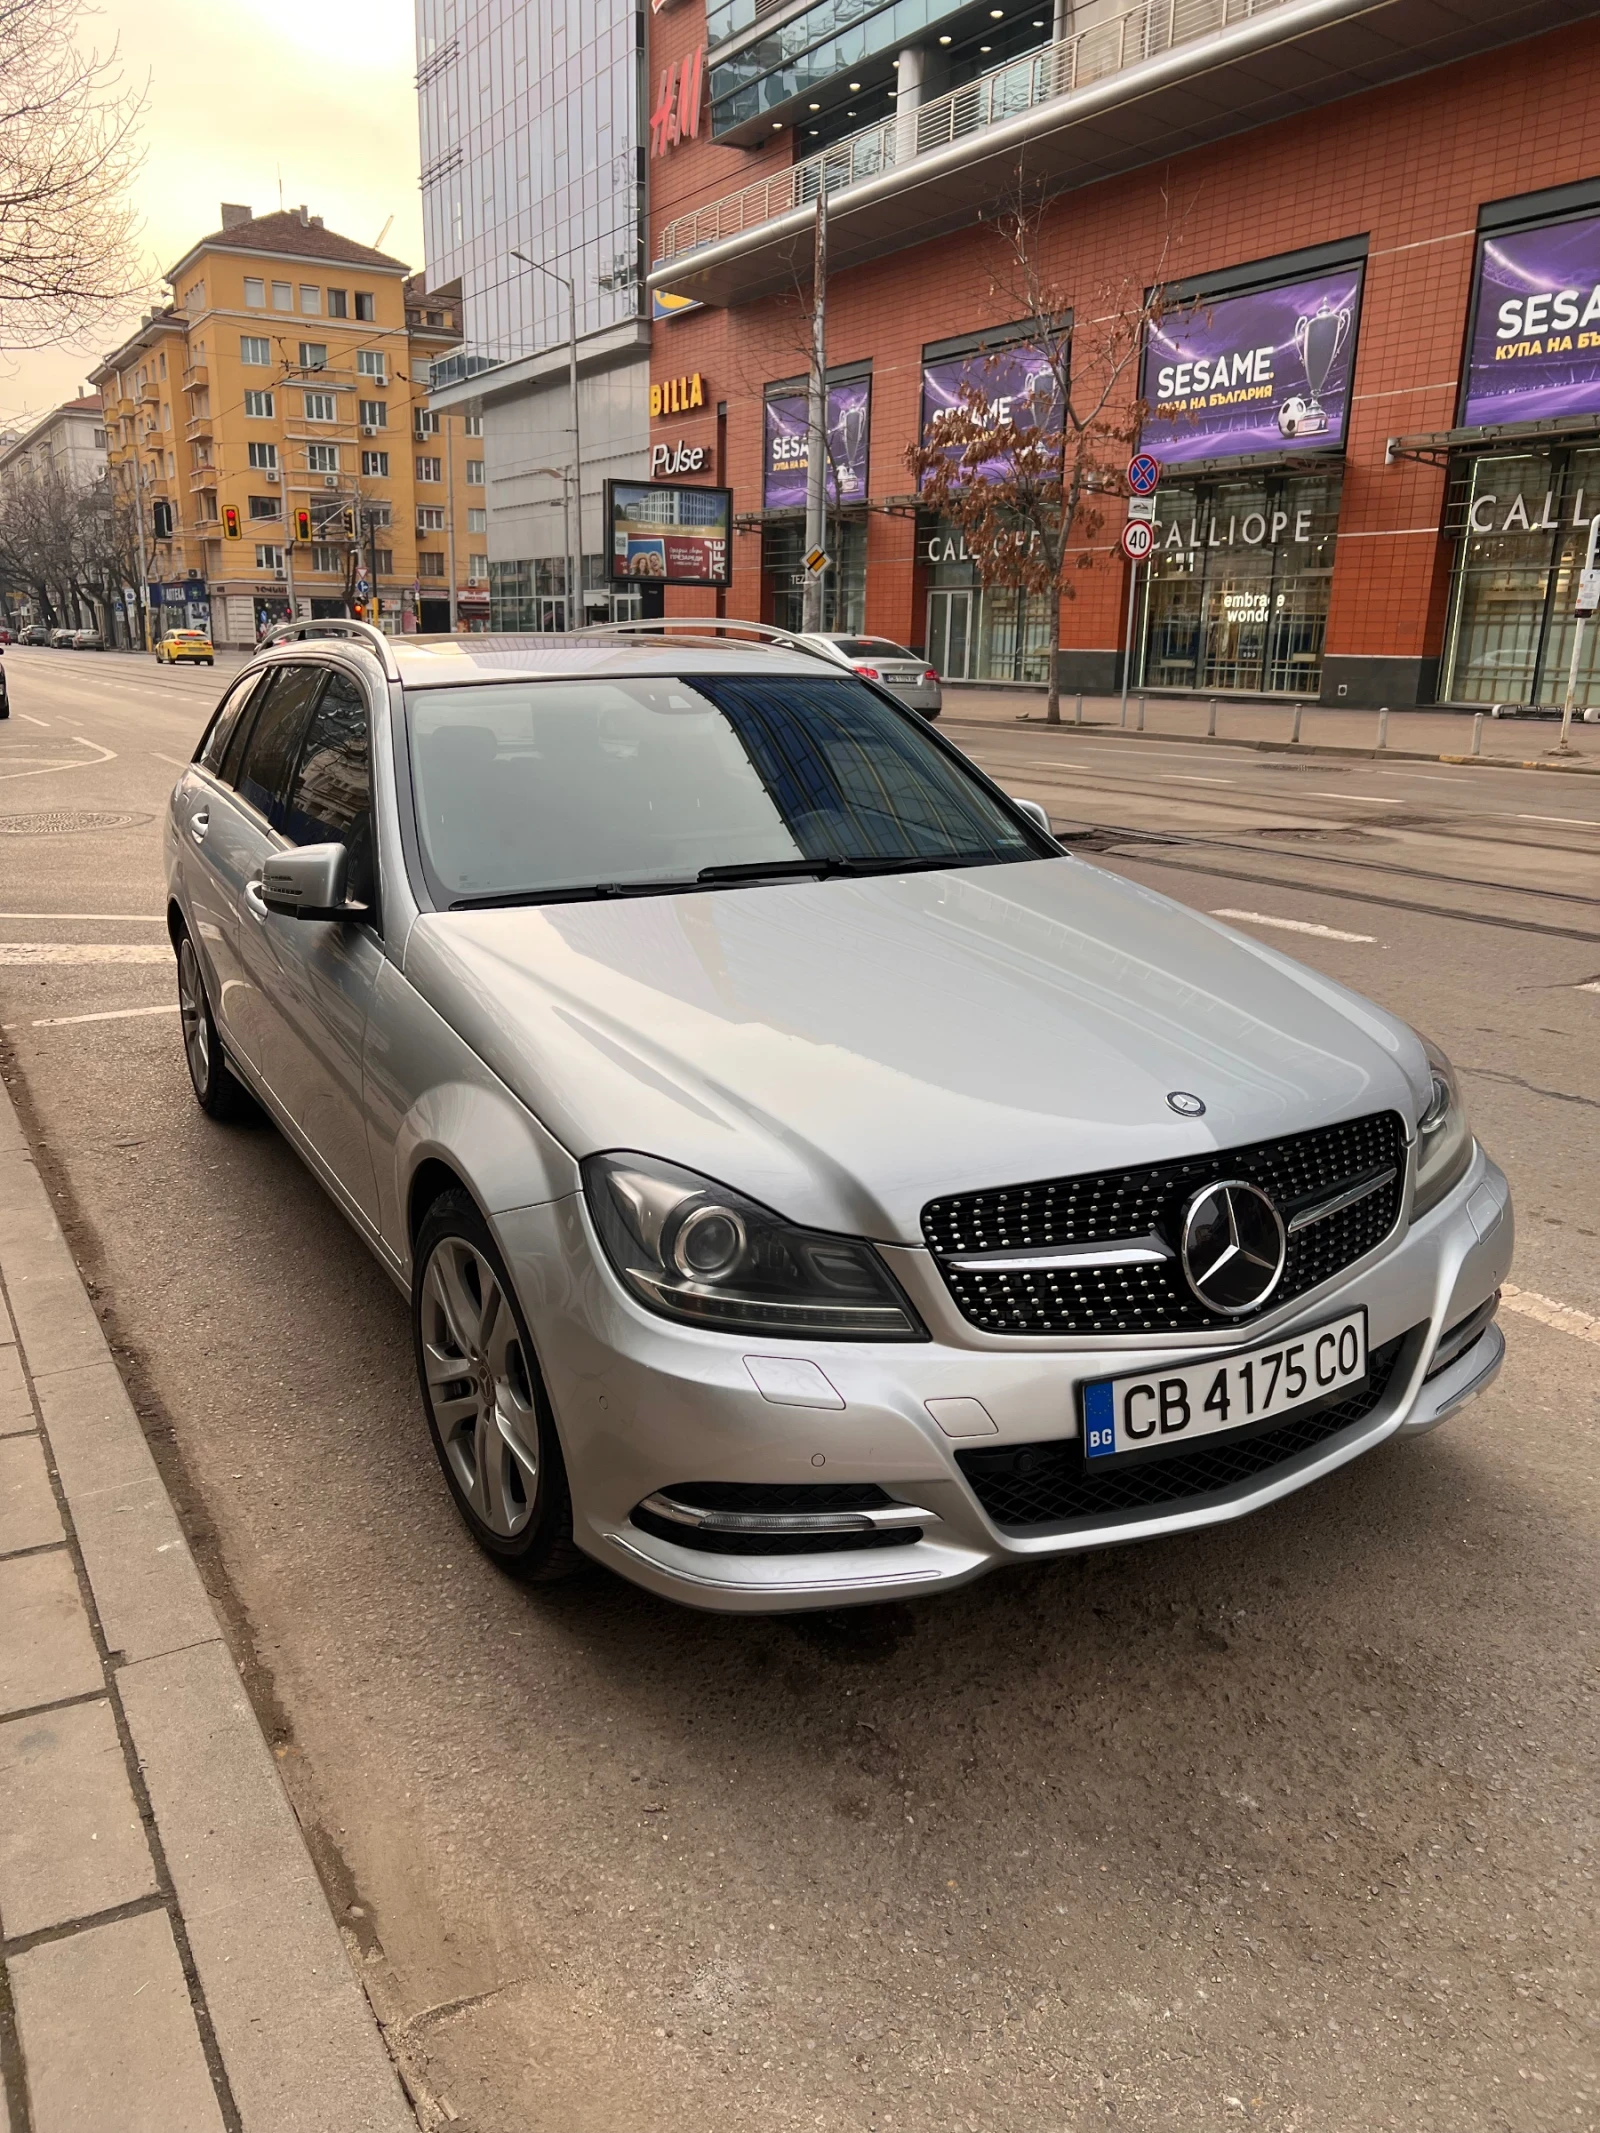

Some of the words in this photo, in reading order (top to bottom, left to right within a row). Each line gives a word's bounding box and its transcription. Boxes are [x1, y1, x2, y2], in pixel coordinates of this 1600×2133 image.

[650, 44, 704, 159] H&M
[1495, 340, 1542, 360] КУПА
[1547, 336, 1573, 353] НА
[650, 373, 703, 417] BILLA
[1190, 397, 1206, 410] НА
[1209, 385, 1273, 407] БЪЛГАРИЯ
[651, 440, 704, 477] Pulse
[1129, 531, 1147, 549] 40
[1124, 1377, 1191, 1440] CB
[1204, 1343, 1307, 1422] 4175
[1315, 1324, 1358, 1387] CO
[1089, 1429, 1113, 1448] BG
